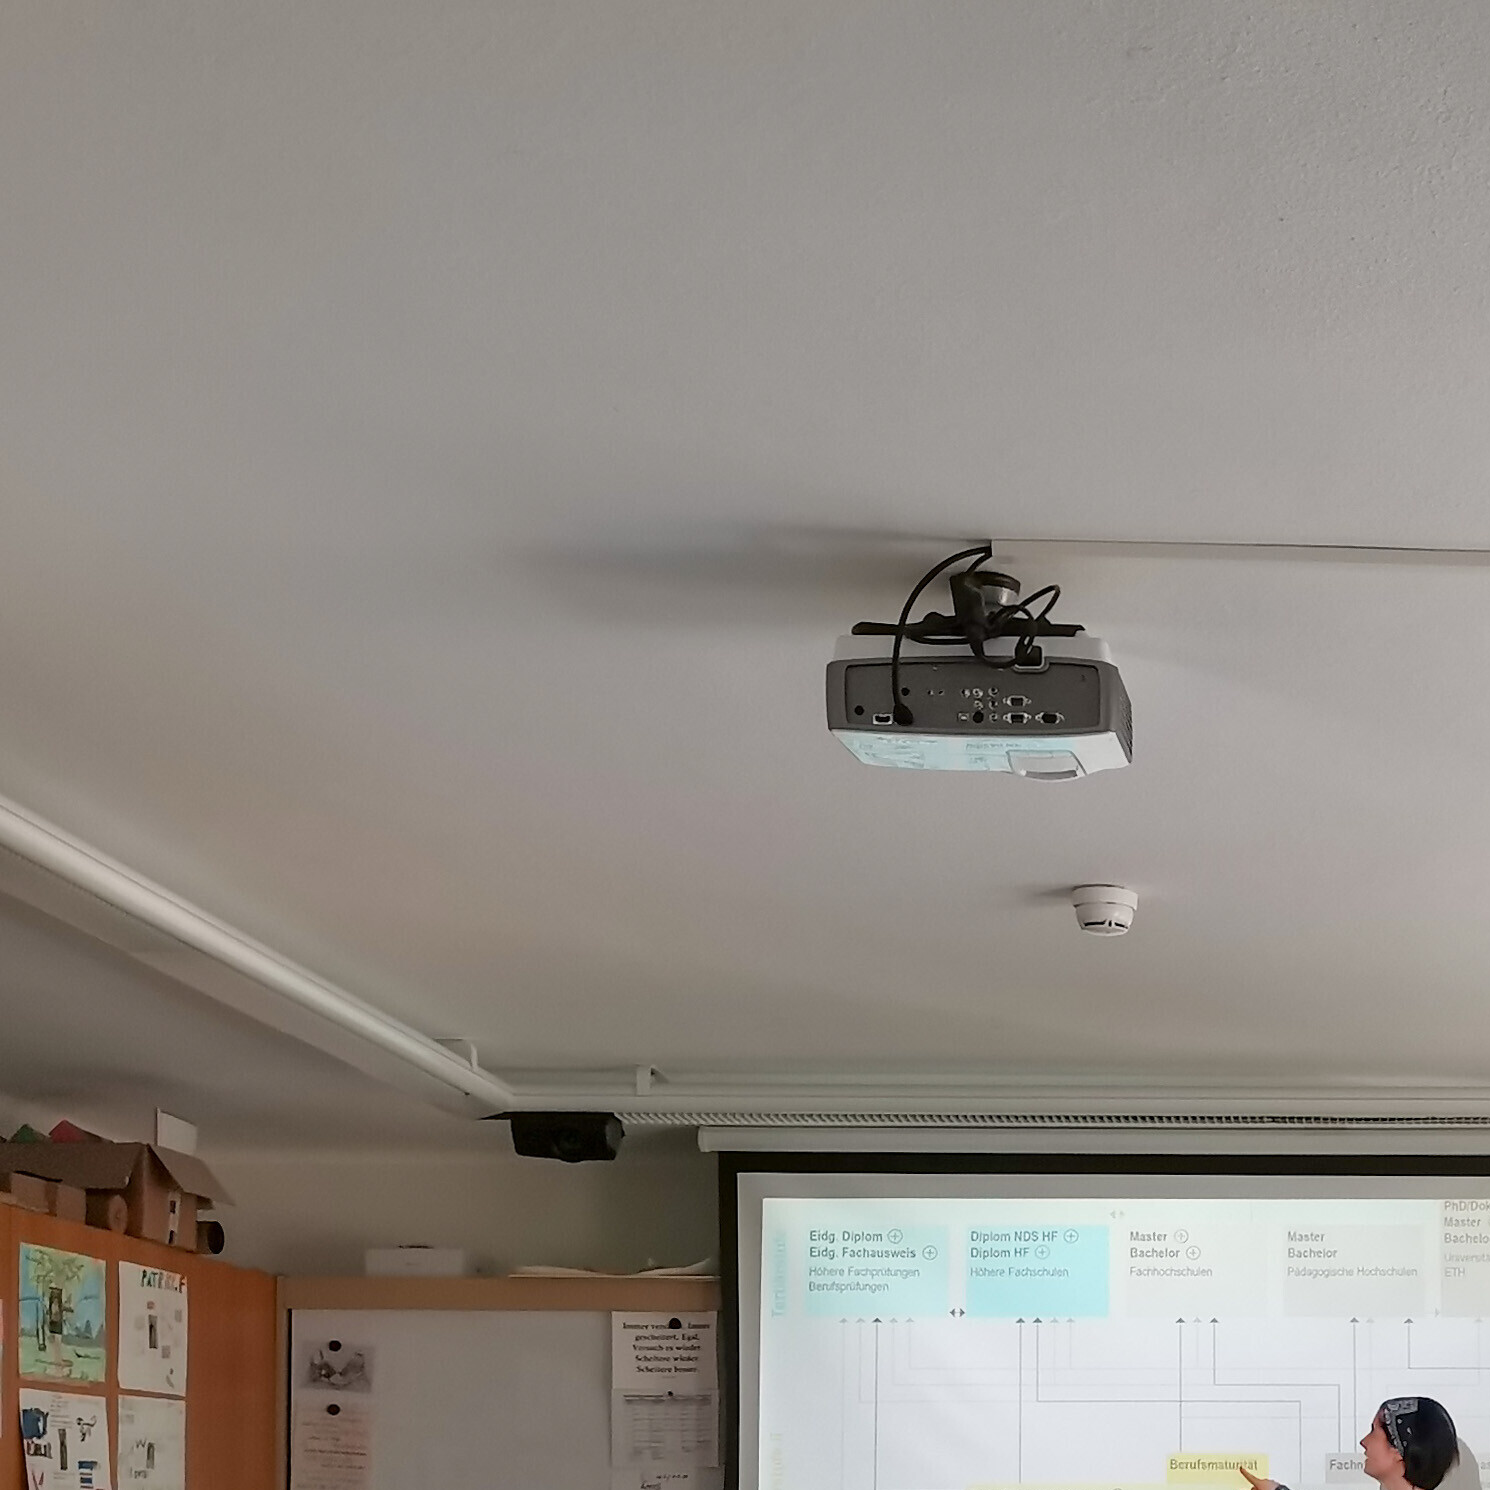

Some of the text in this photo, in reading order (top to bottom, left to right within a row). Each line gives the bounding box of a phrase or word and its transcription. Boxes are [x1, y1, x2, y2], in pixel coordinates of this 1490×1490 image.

[1444, 1217, 1481, 1228] Master
[809, 1230, 883, 1244] Eidg. Diplom
[970, 1230, 1058, 1244] Diplom NDS HF
[1130, 1231, 1168, 1242] Master
[1287, 1231, 1325, 1242] Master
[809, 1246, 916, 1260] Eidg. Fachausweis
[970, 1247, 1030, 1260] Diplom HF
[1130, 1247, 1180, 1259] Bachelor
[1287, 1247, 1338, 1259] Bachelor
[1008, 1265, 1069, 1277] Fachschulen
[1130, 1265, 1213, 1277] Fachhochschulen
[1357, 1265, 1418, 1277] Hochschulen
[1444, 1266, 1466, 1278] ETH
